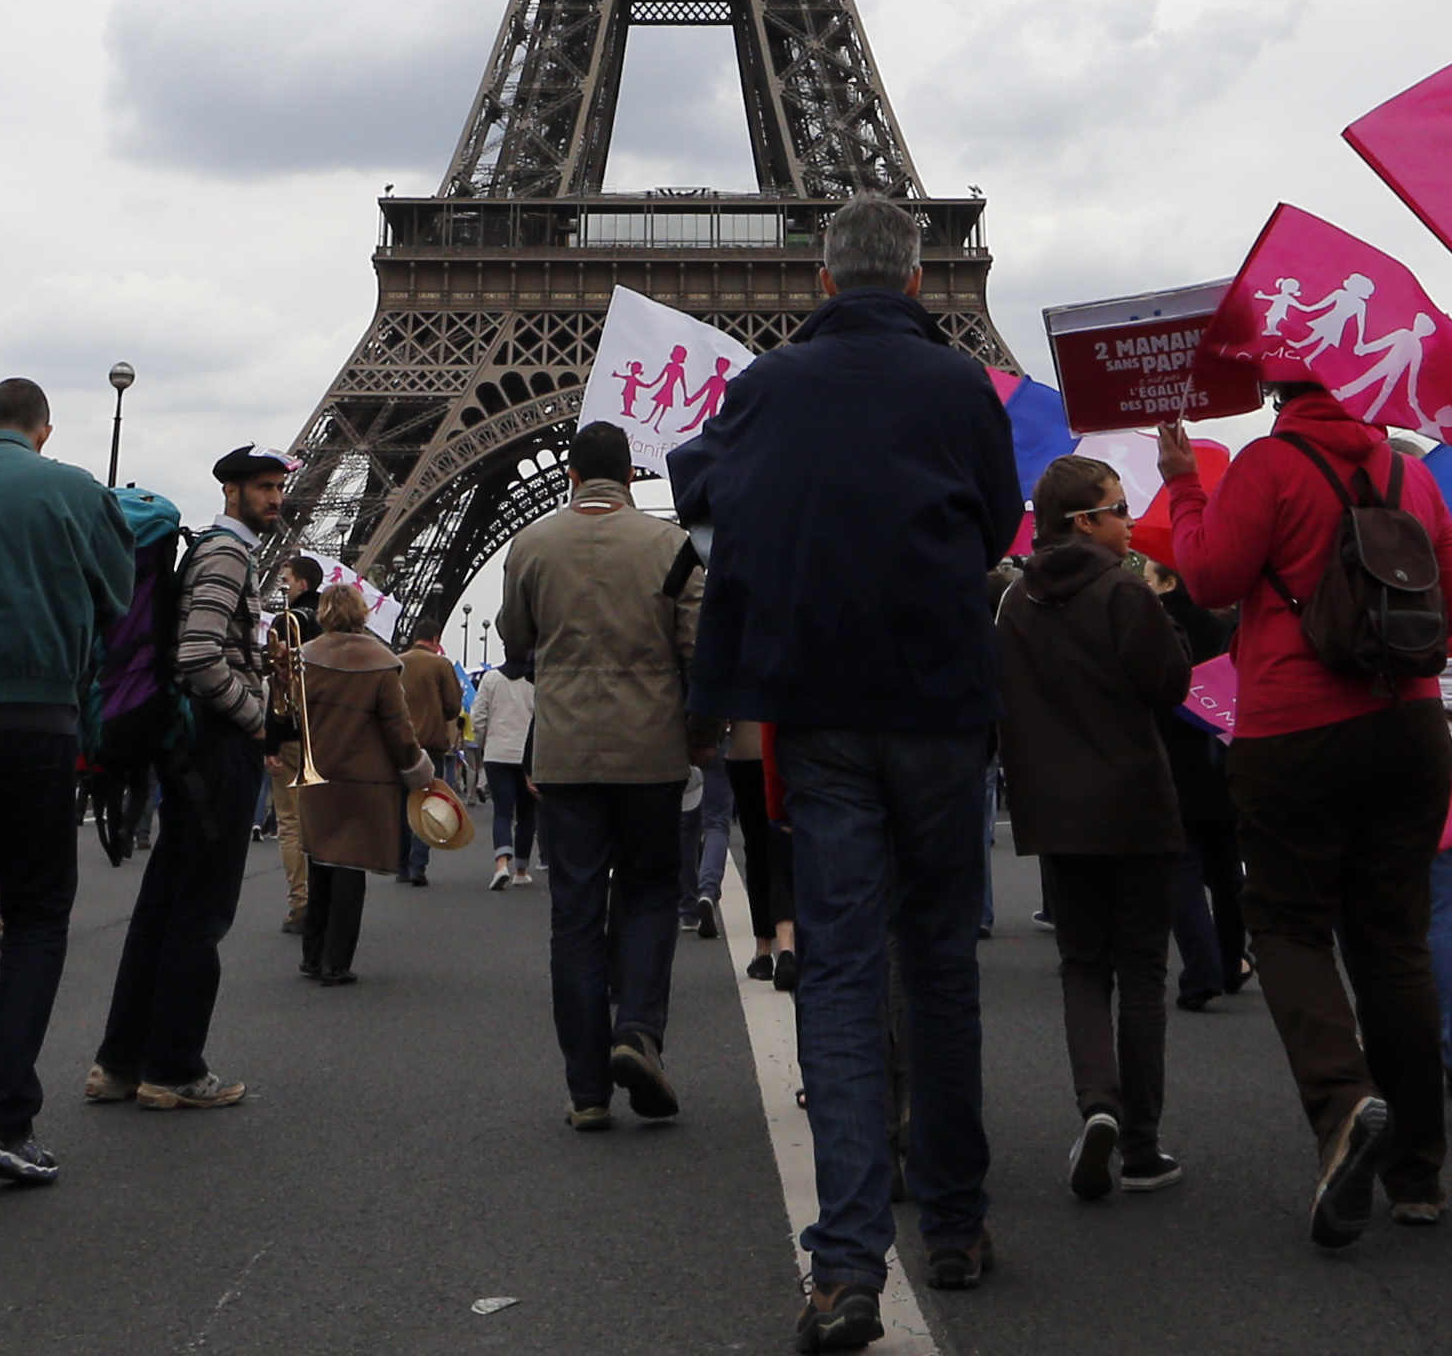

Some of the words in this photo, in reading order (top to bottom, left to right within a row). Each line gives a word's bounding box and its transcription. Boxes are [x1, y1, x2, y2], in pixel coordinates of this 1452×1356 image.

[1094, 342, 1109, 360] 2
[1115, 329, 1206, 357] MAMAN
[1106, 357, 1140, 372] SANS
[1119, 399, 1142, 412] DES
[1189, 685, 1219, 709] La
